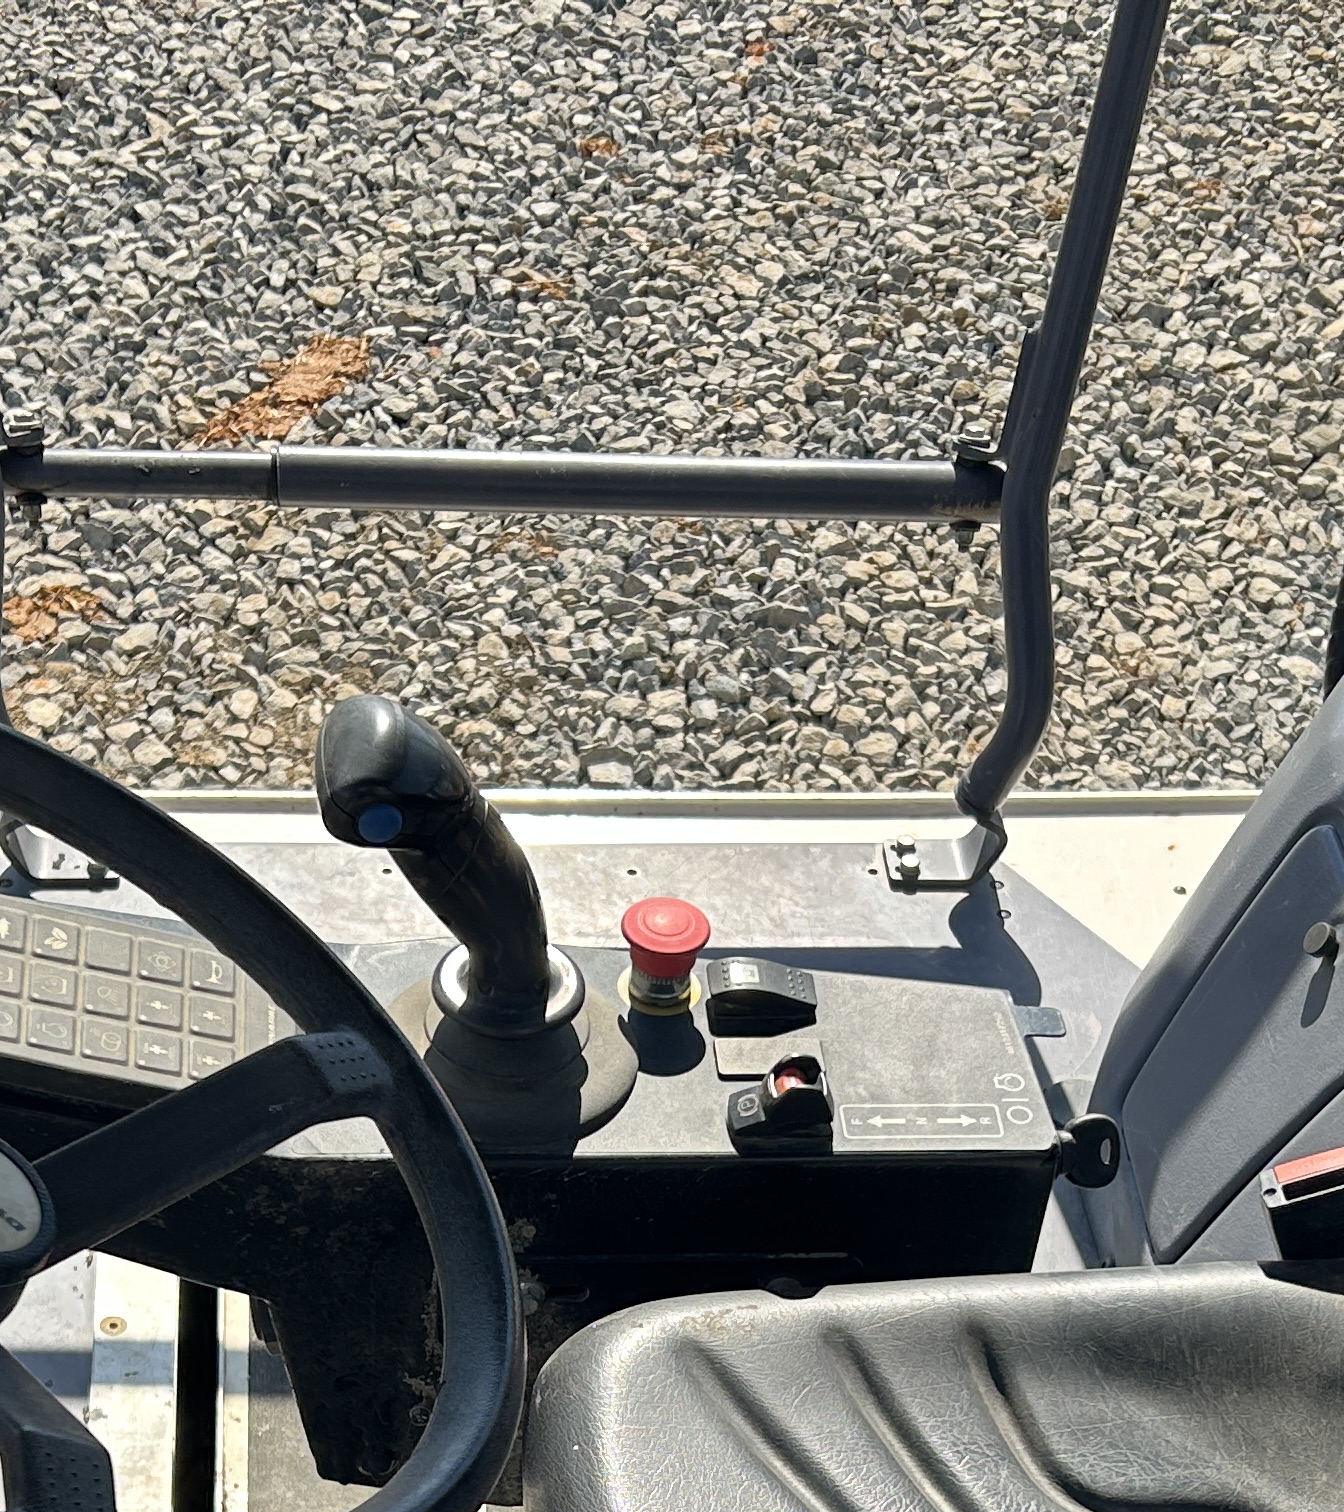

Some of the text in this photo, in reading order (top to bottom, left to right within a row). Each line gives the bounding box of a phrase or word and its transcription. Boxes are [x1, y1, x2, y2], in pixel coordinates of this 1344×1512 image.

[851, 1117, 992, 1126] F N R
